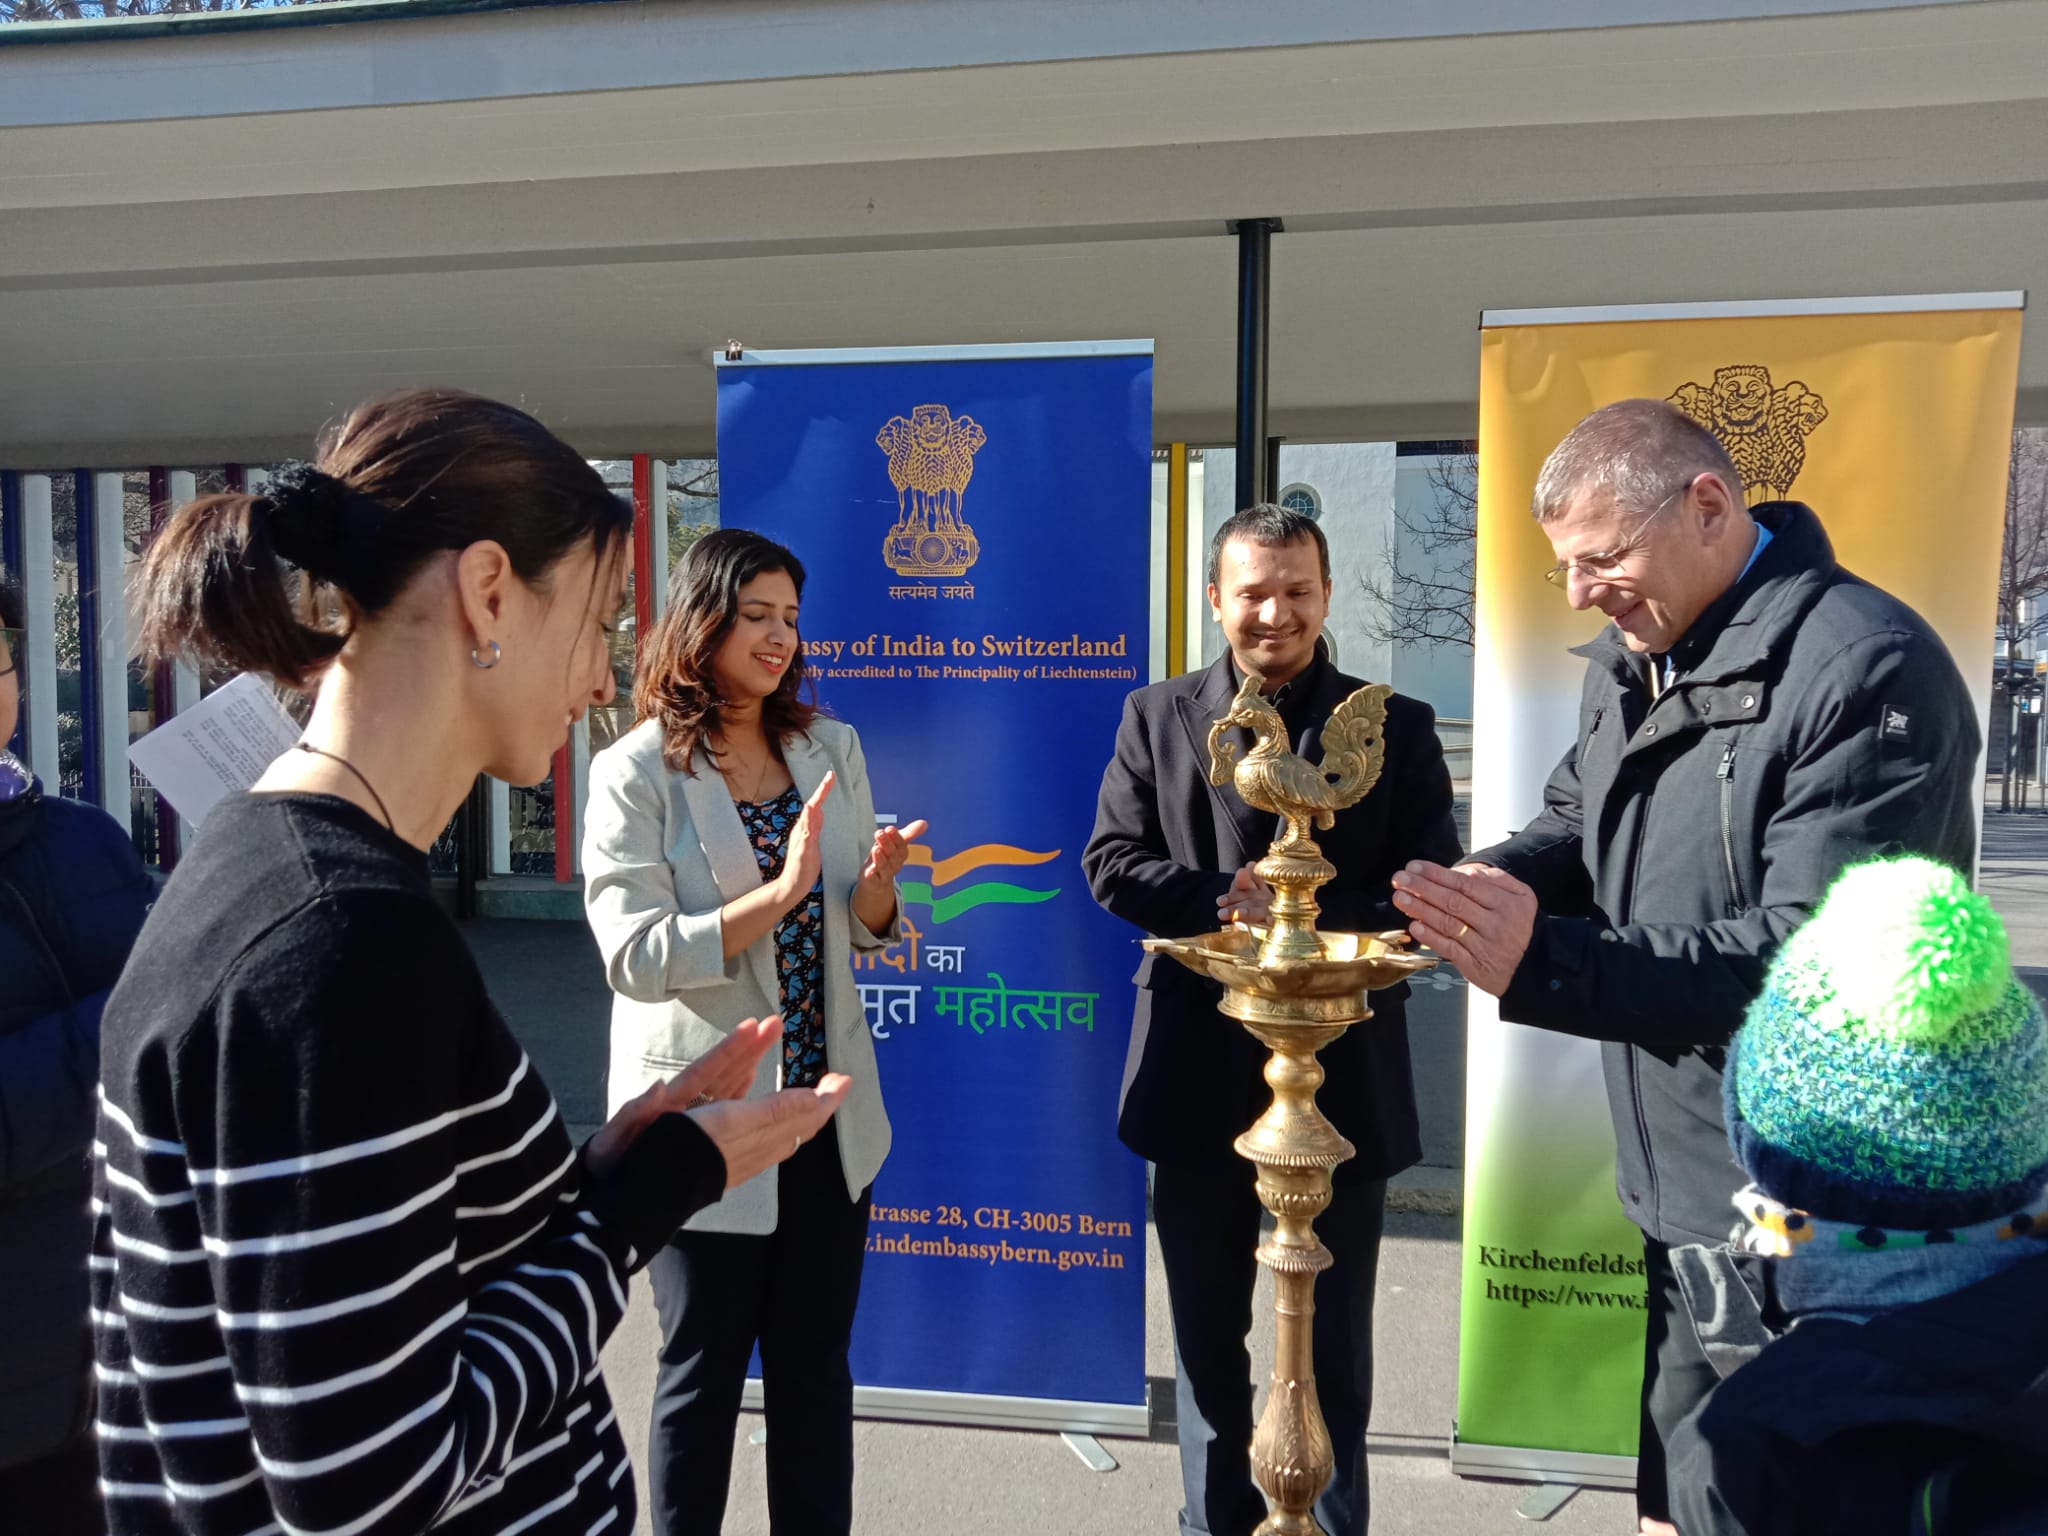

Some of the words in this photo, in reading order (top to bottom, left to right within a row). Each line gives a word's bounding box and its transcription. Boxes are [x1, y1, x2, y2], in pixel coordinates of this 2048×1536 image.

[888, 580, 938, 600] सत्यमेव
[941, 580, 976, 600] जयते
[801, 639, 846, 663] assy
[851, 634, 878, 656] of
[882, 634, 945, 656] India
[952, 637, 976, 656] to
[982, 634, 1127, 657] Switzerland
[827, 665, 895, 678] accredited
[899, 667, 912, 678] to
[915, 665, 940, 678] The
[943, 665, 1018, 682] Principality
[1023, 665, 1039, 679] of
[1040, 666, 1137, 681] Liechtenstein)
[925, 945, 966, 973] का
[855, 984, 922, 1039] मृत
[933, 972, 1100, 1034] महोत्सव
[870, 1203, 931, 1224] trasse
[936, 1205, 968, 1228] 28,
[974, 1207, 1072, 1233] CH-3005
[1078, 1215, 1132, 1237] Bern
[864, 1233, 1125, 1271] .indembassybern.gov.in
[1479, 1245, 1646, 1275] Kirchenfeldst
[1486, 1279, 1648, 1309] https://www.i
